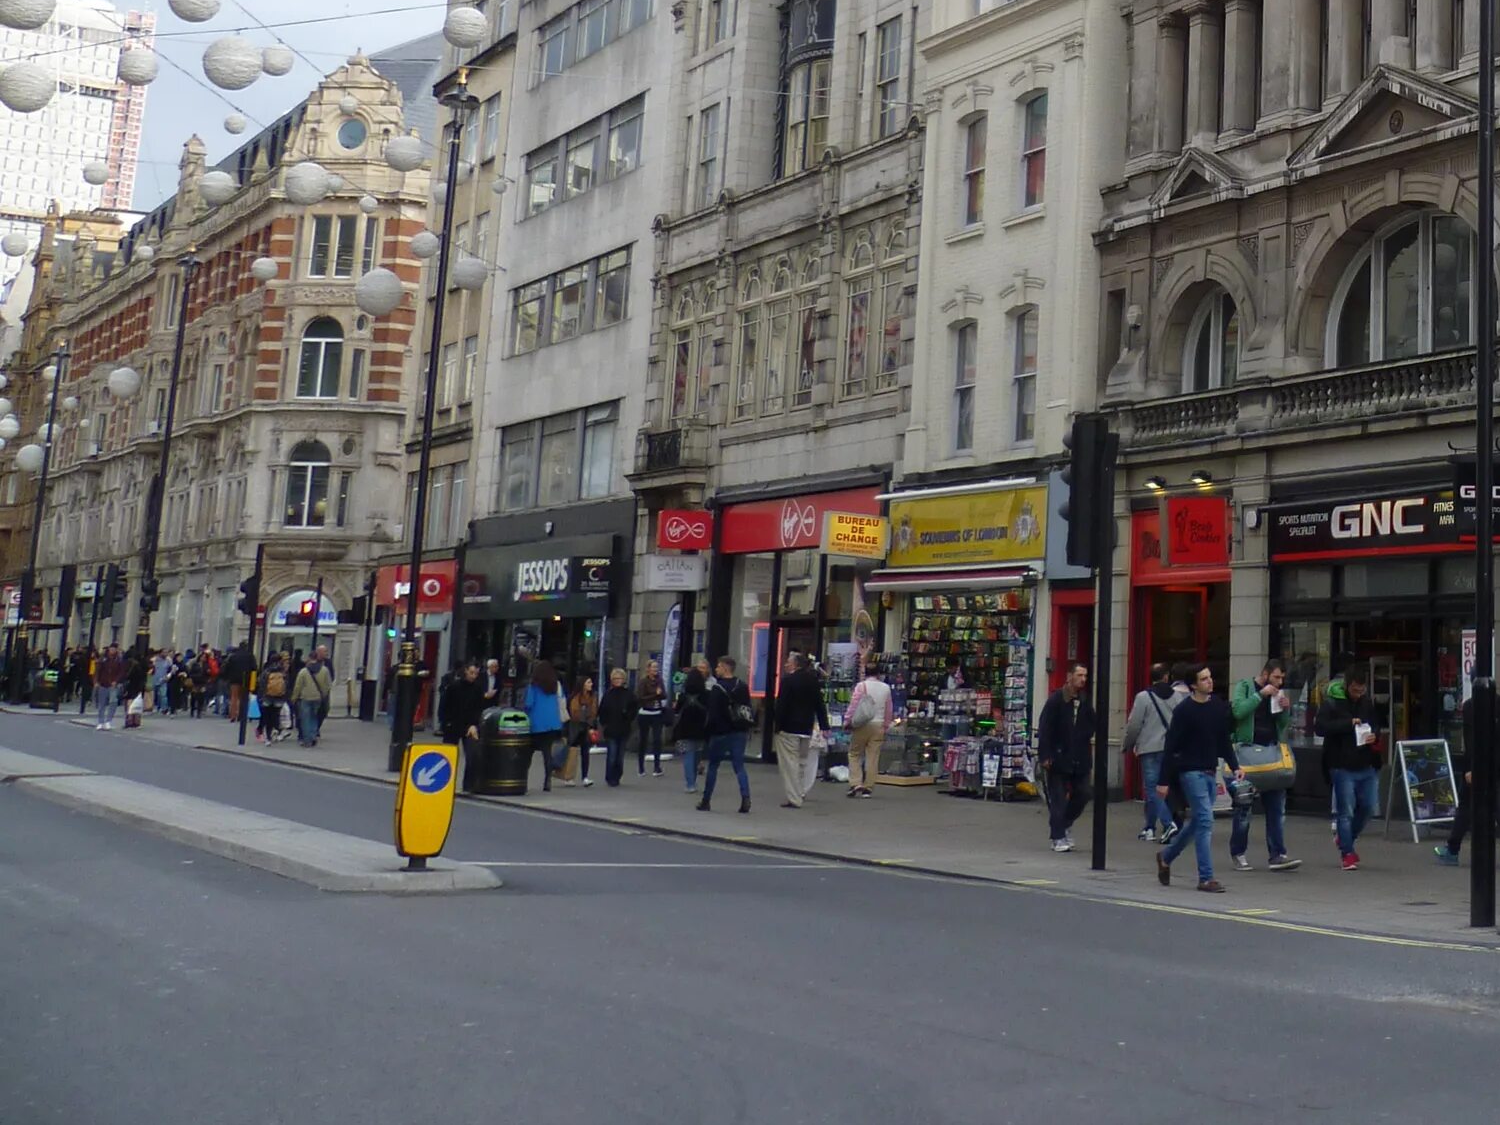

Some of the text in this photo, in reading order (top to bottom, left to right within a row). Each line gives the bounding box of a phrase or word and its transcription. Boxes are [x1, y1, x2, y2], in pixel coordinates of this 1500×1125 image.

[1433, 501, 1455, 513] FITNES
[837, 515, 880, 527] BUREAU
[1278, 512, 1329, 525] SPORTS NUTRITION
[1330, 497, 1425, 539] GNC
[851, 525, 865, 535] DE
[962, 528, 974, 543] OF
[975, 526, 1009, 541] LONDON
[1289, 525, 1317, 537] SPECIALIST
[835, 532, 878, 545] CHANGE
[513, 557, 570, 602] JESSOPS
